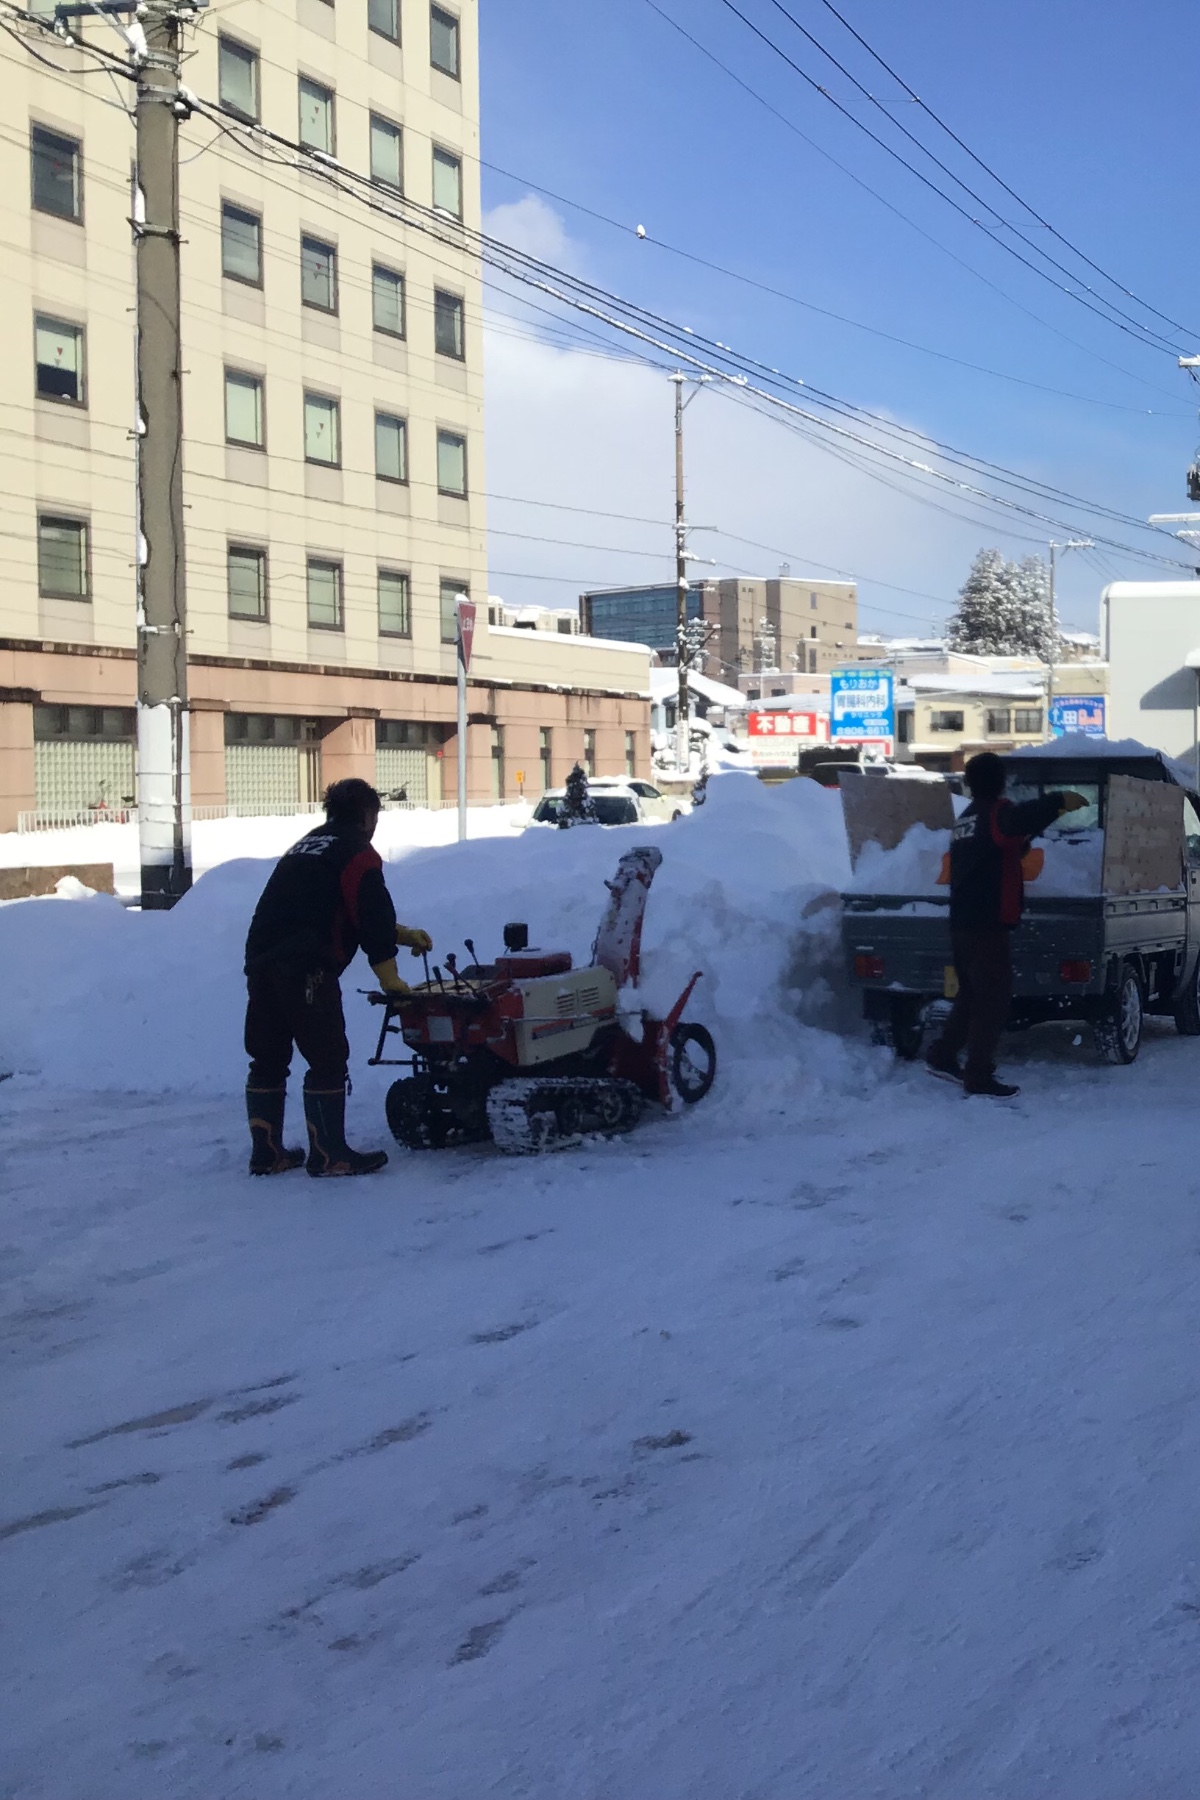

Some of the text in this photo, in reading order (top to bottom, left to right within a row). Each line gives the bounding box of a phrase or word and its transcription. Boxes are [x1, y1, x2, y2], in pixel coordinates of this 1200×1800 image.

[839, 679, 878, 689] もりおか
[756, 715, 810, 734] 不動産
